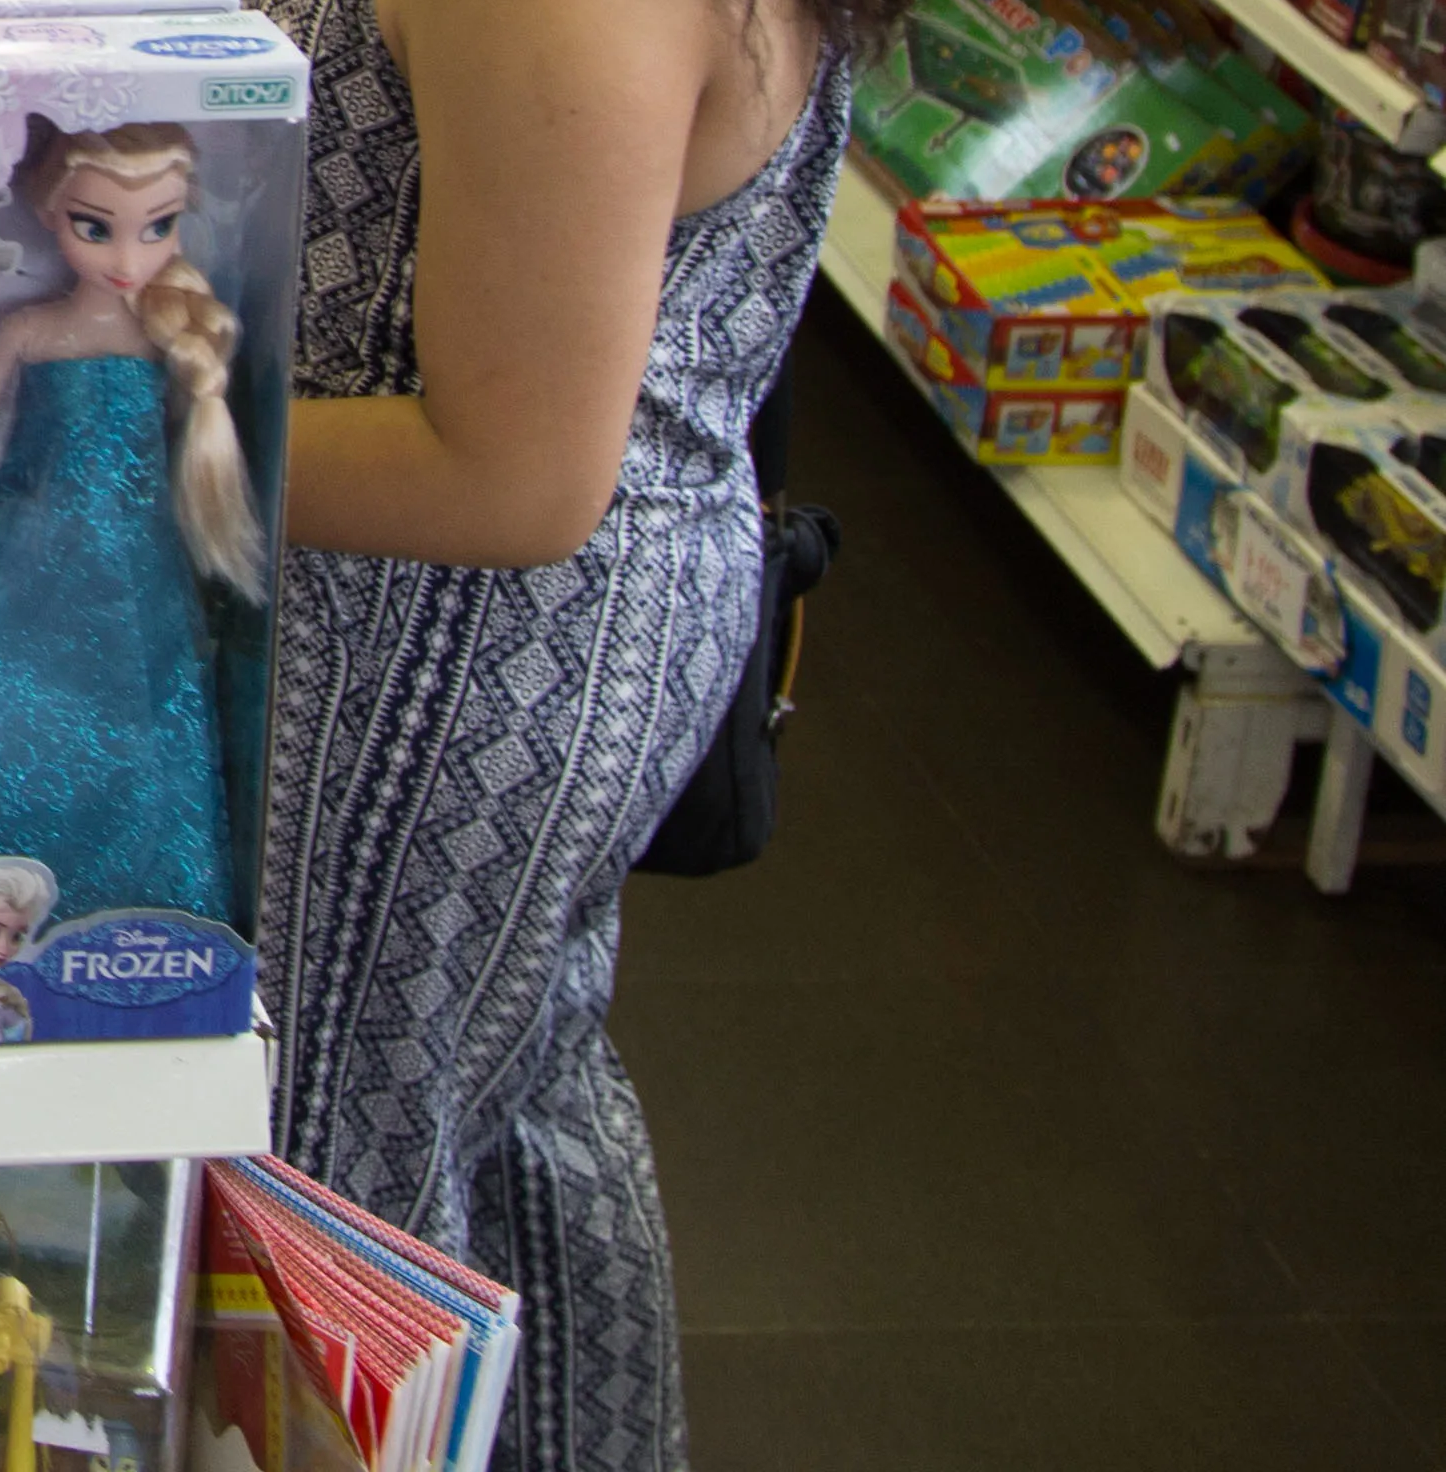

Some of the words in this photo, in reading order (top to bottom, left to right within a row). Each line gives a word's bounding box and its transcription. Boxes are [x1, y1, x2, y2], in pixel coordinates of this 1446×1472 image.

[150, 38, 259, 54] FROZEN
[208, 82, 291, 106] DITOYS
[112, 929, 170, 950] Disney
[61, 947, 214, 984] FROZEN
